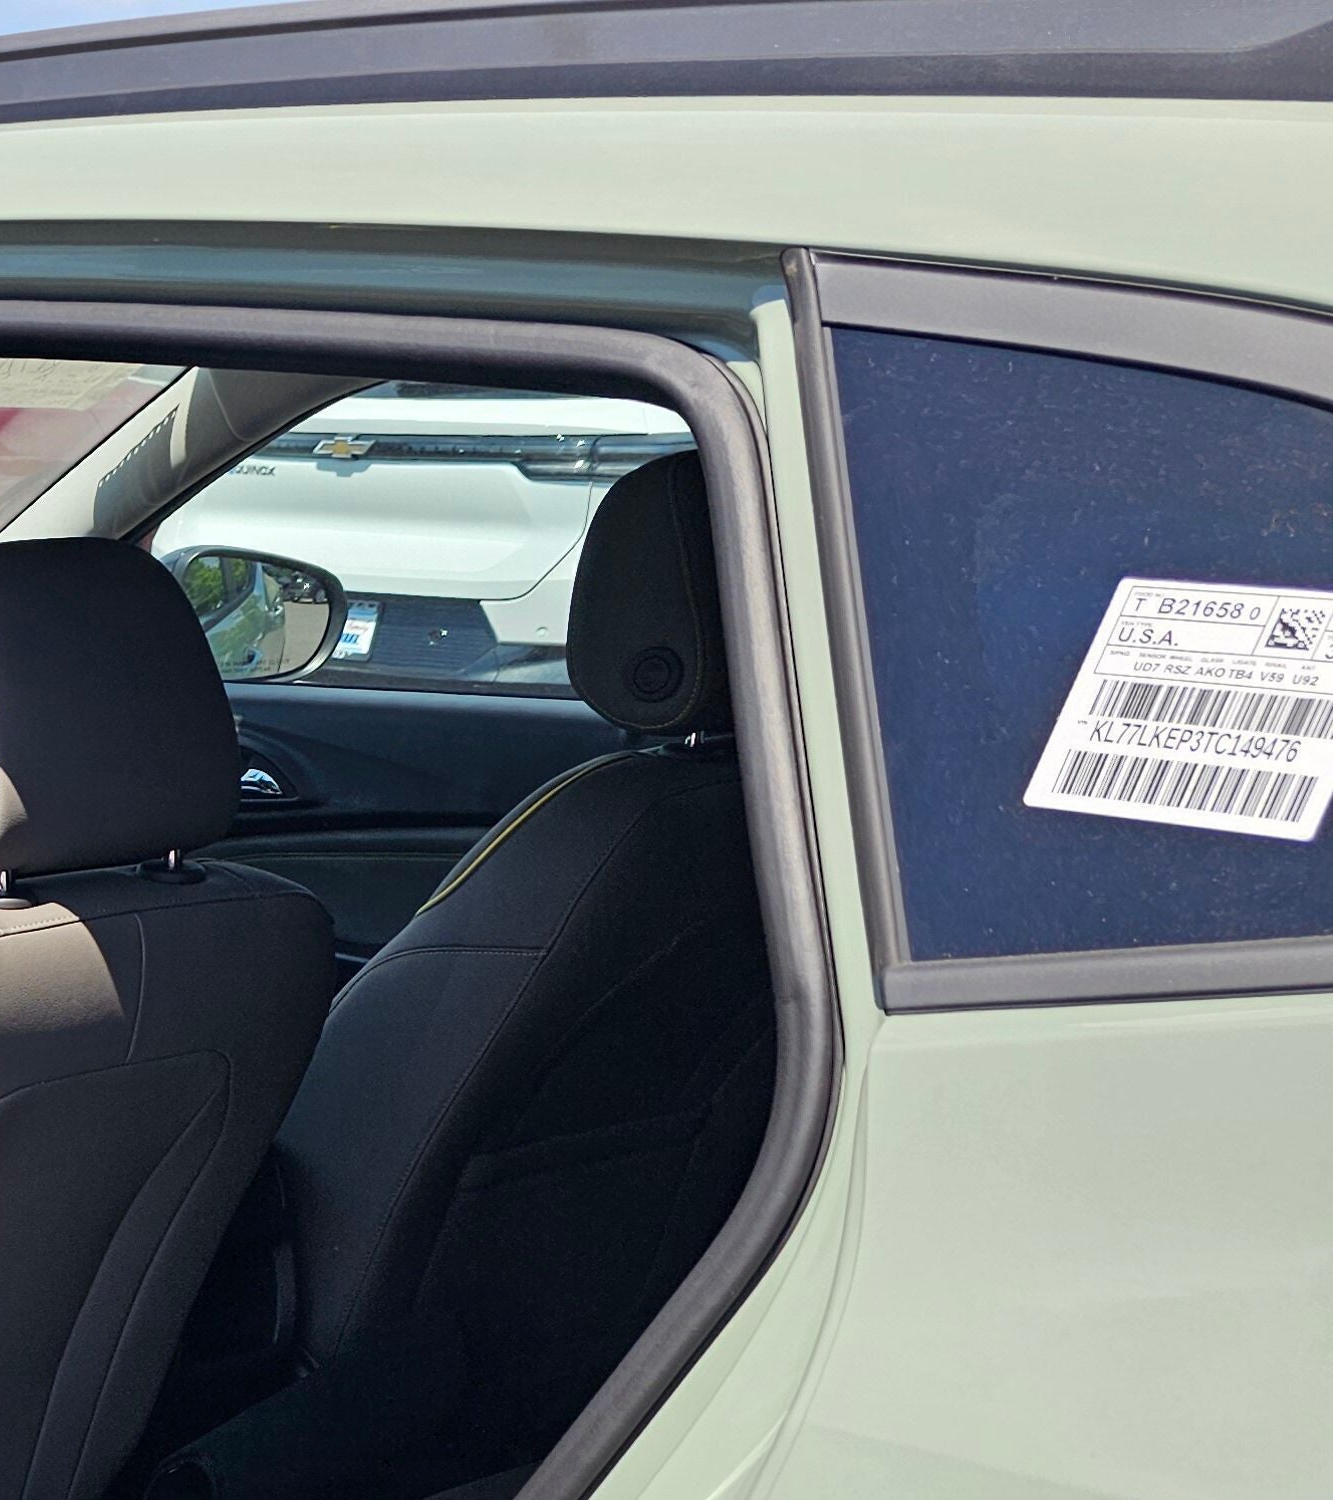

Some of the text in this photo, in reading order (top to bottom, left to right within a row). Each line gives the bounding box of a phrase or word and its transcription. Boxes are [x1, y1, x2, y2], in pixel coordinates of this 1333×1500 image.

[1135, 598, 1148, 611] T
[1158, 598, 1244, 620] B21658
[1118, 627, 1179, 647] U.S.A.
[1133, 661, 1162, 673] UD7
[1164, 663, 1192, 675] RSZ
[1229, 668, 1254, 680] TB4
[1260, 671, 1285, 683] V59
[1292, 674, 1320, 687] U92
[1089, 719, 1302, 763] KL77LKEP3TC149476
